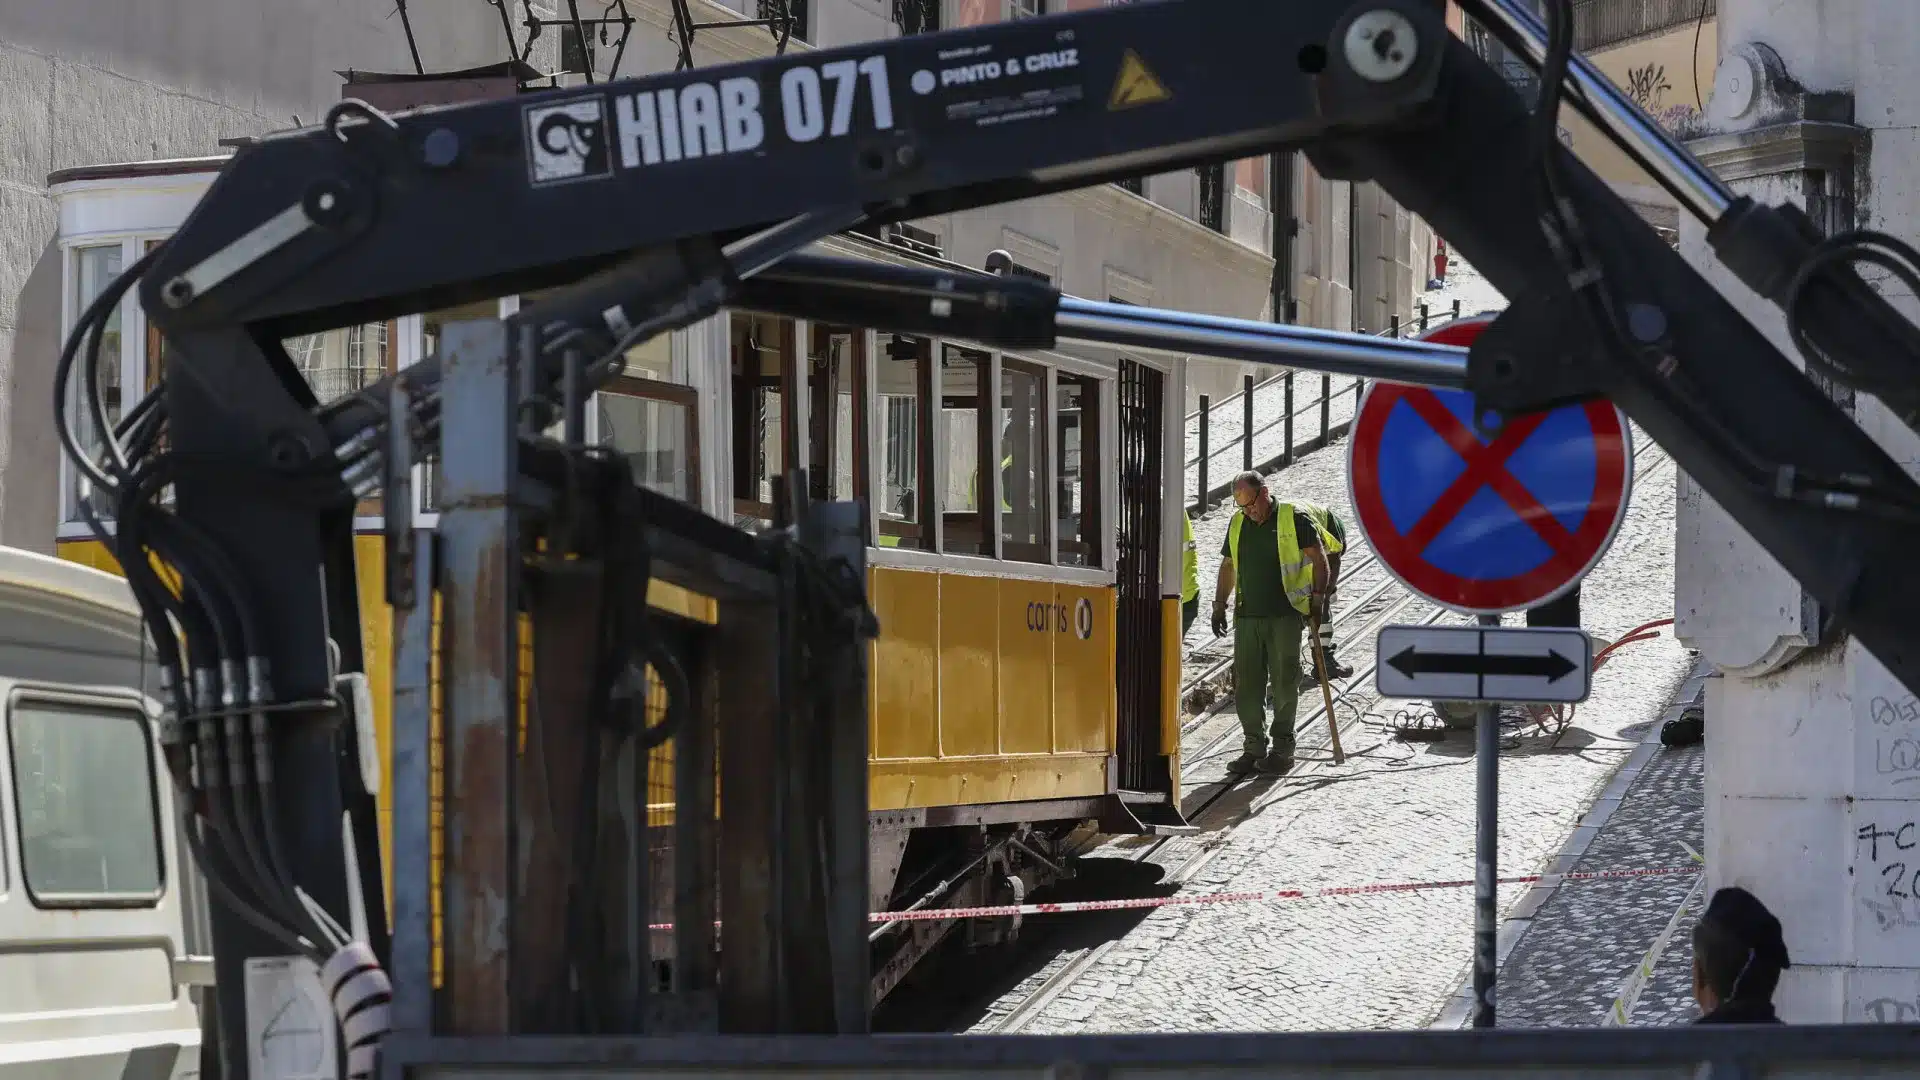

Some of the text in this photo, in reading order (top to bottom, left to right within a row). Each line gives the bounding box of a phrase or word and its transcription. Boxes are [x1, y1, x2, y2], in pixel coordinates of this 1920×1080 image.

[940, 48, 1079, 87] PINTO & CRUZ
[614, 55, 893, 169] HIAB 071
[1026, 591, 1068, 633] carris
